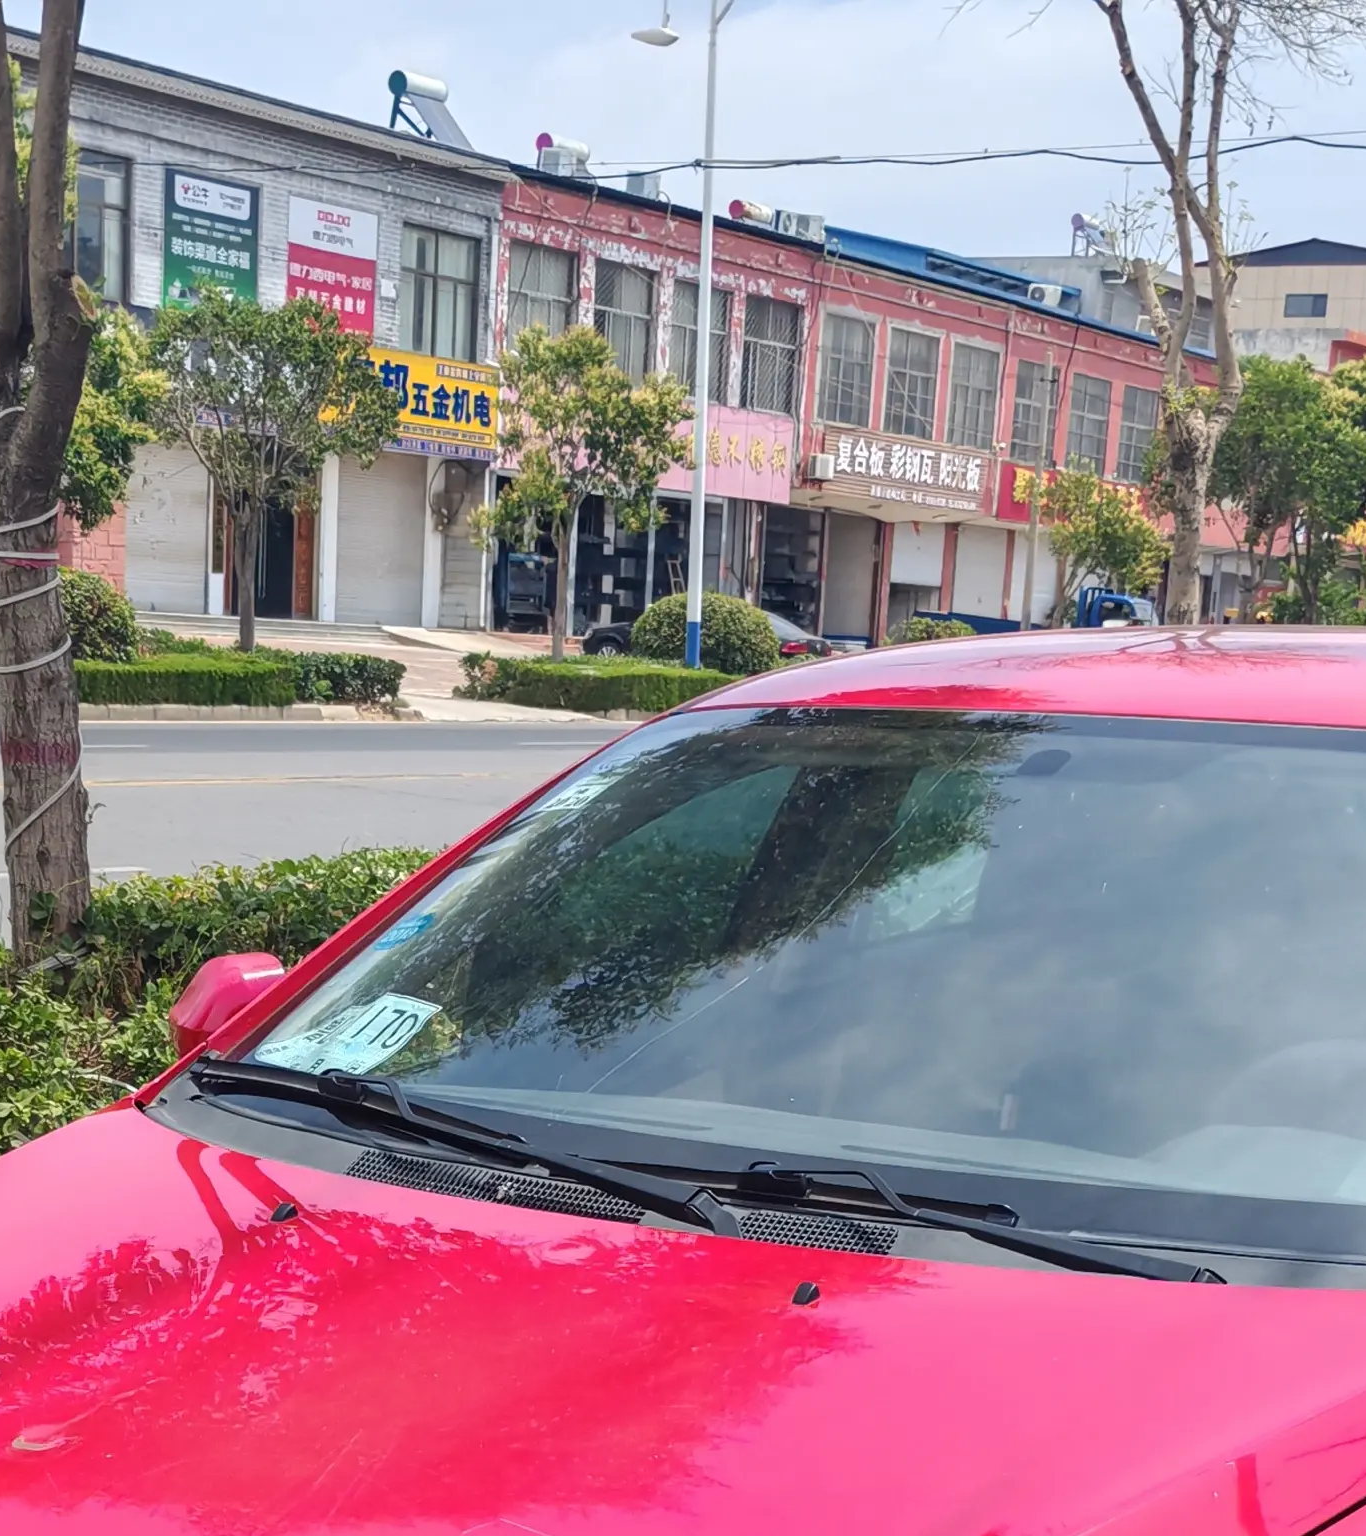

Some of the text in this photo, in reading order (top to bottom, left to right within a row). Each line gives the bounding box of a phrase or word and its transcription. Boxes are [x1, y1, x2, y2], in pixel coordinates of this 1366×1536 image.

[836, 434, 885, 477] 复合板
[889, 443, 935, 485] 彩钢瓦
[938, 451, 982, 492] 阳光板
